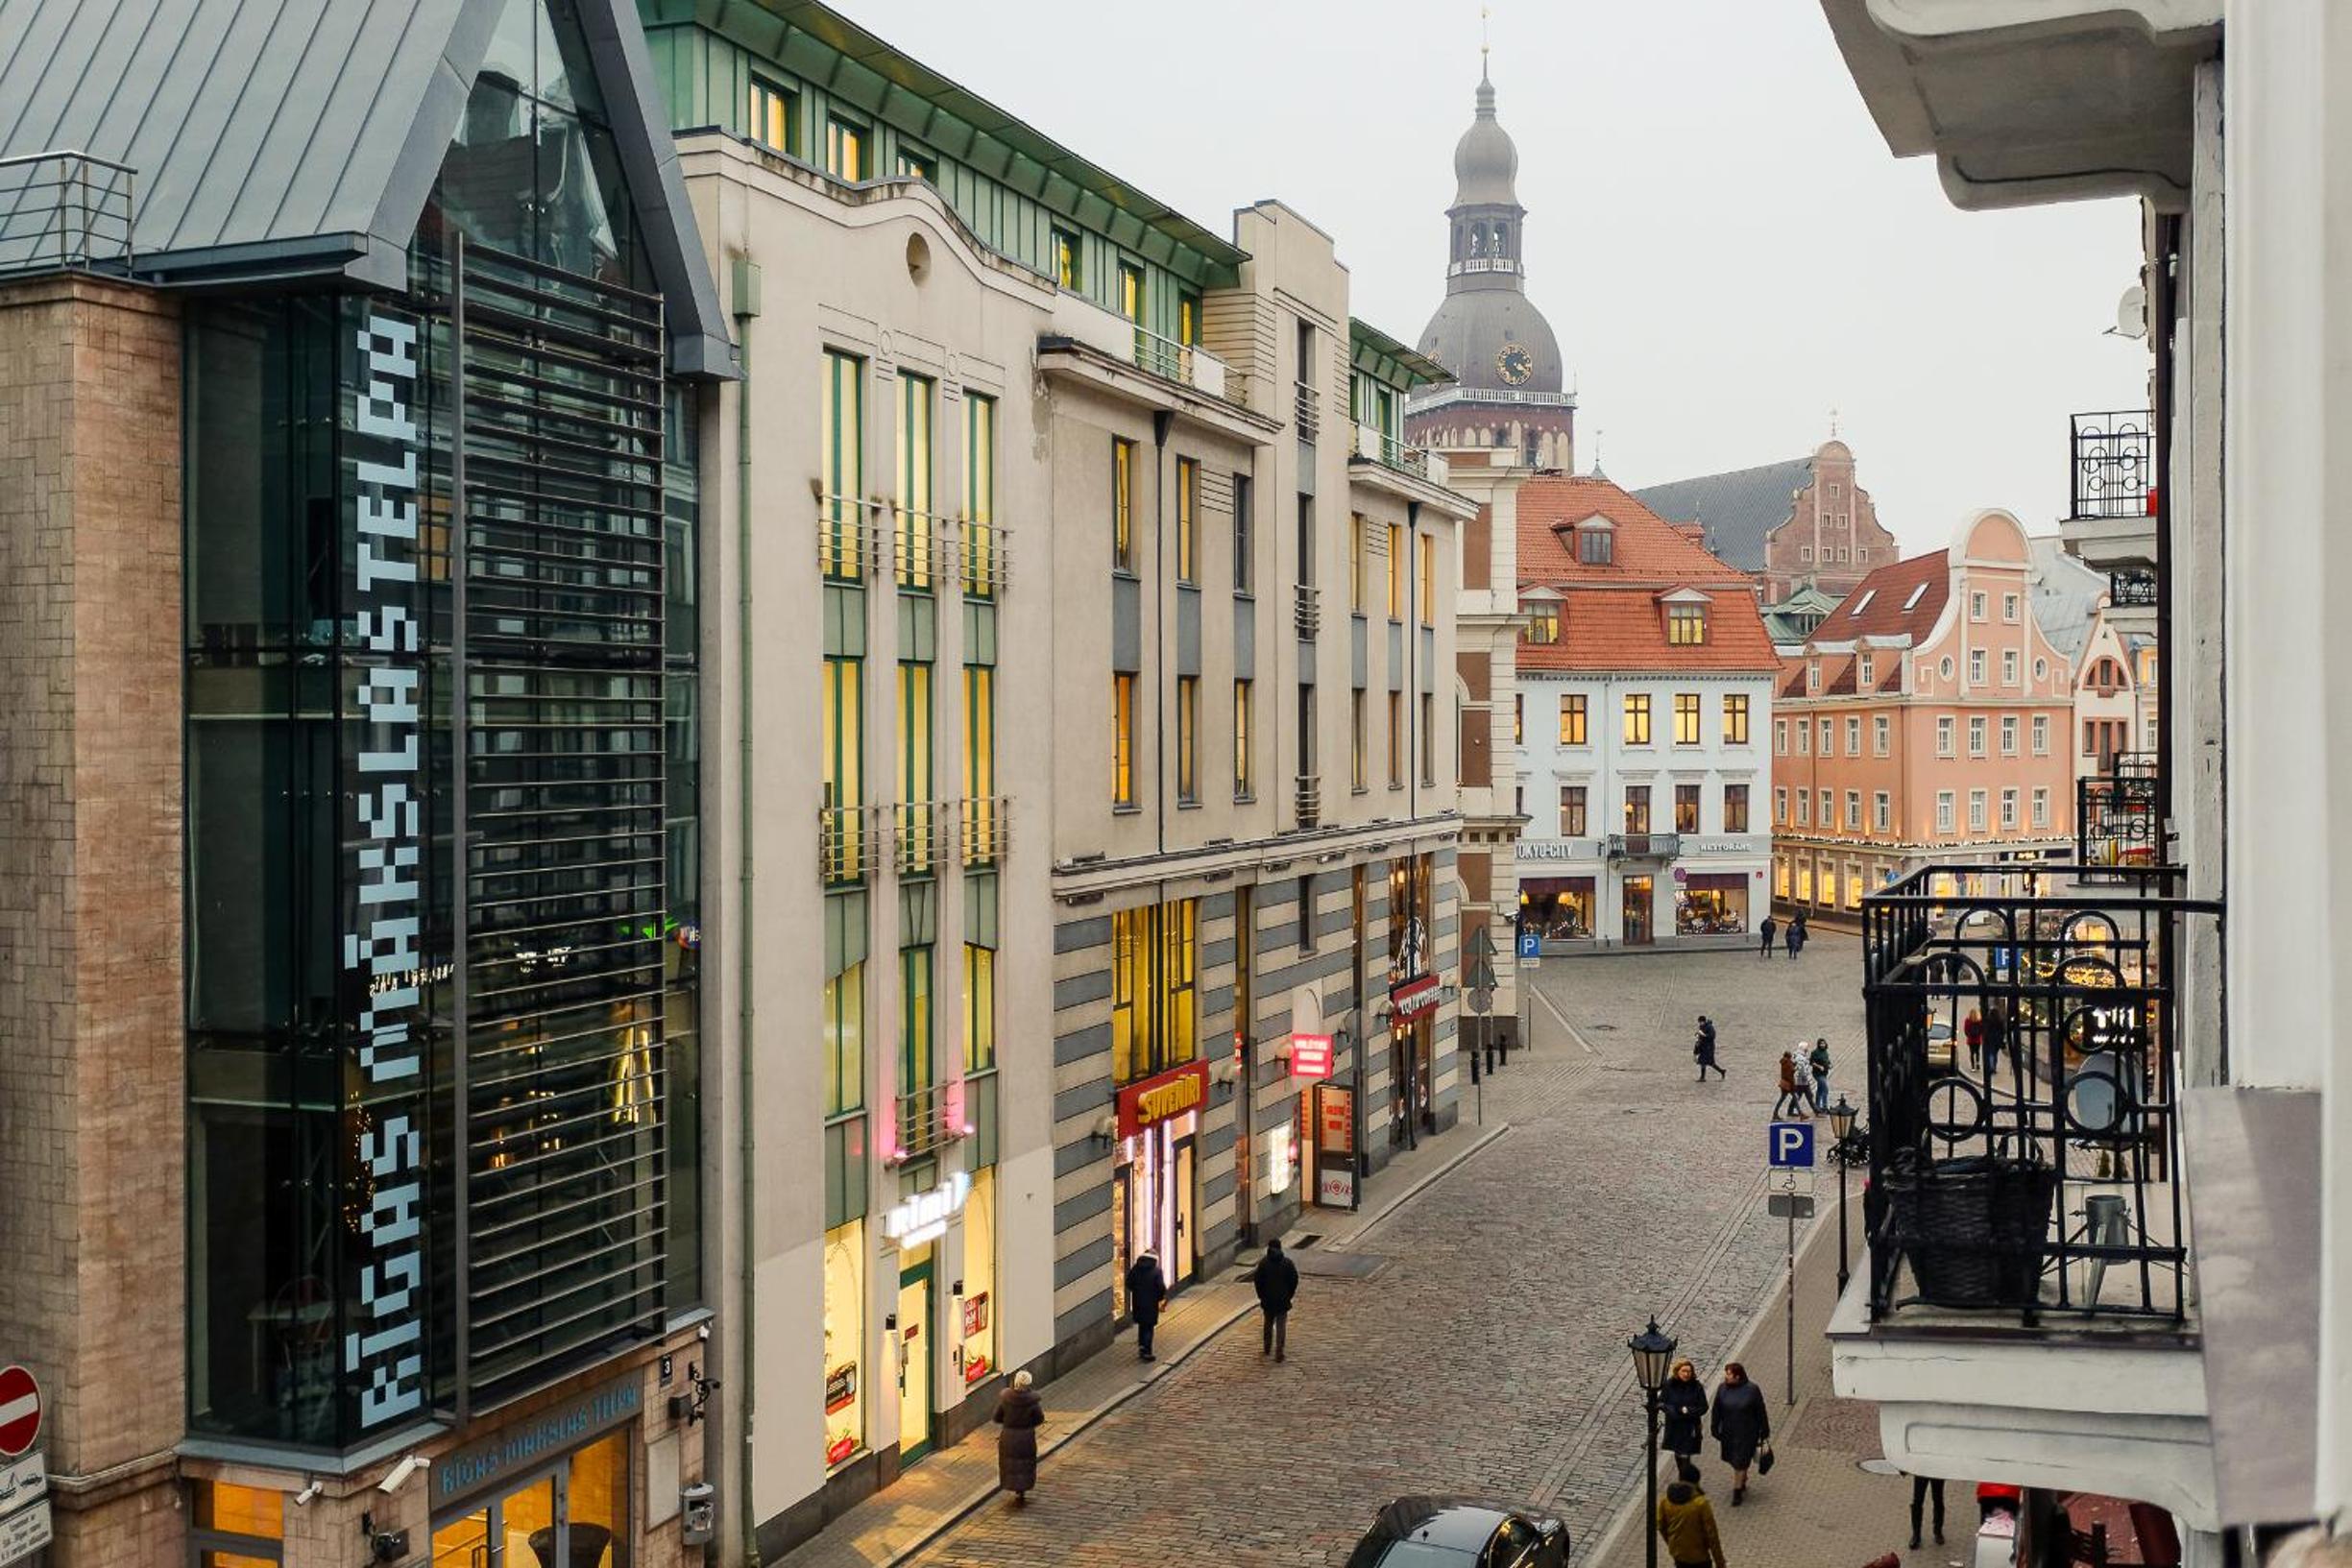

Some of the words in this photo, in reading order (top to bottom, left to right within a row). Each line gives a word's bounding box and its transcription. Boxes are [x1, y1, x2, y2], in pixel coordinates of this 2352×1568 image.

[356, 315, 417, 591] TELPA
[1524, 938, 1535, 953] P
[1779, 1128, 1805, 1161] P
[346, 1115, 421, 1428] RĪGAS
[664, 1360, 670, 1374] 3
